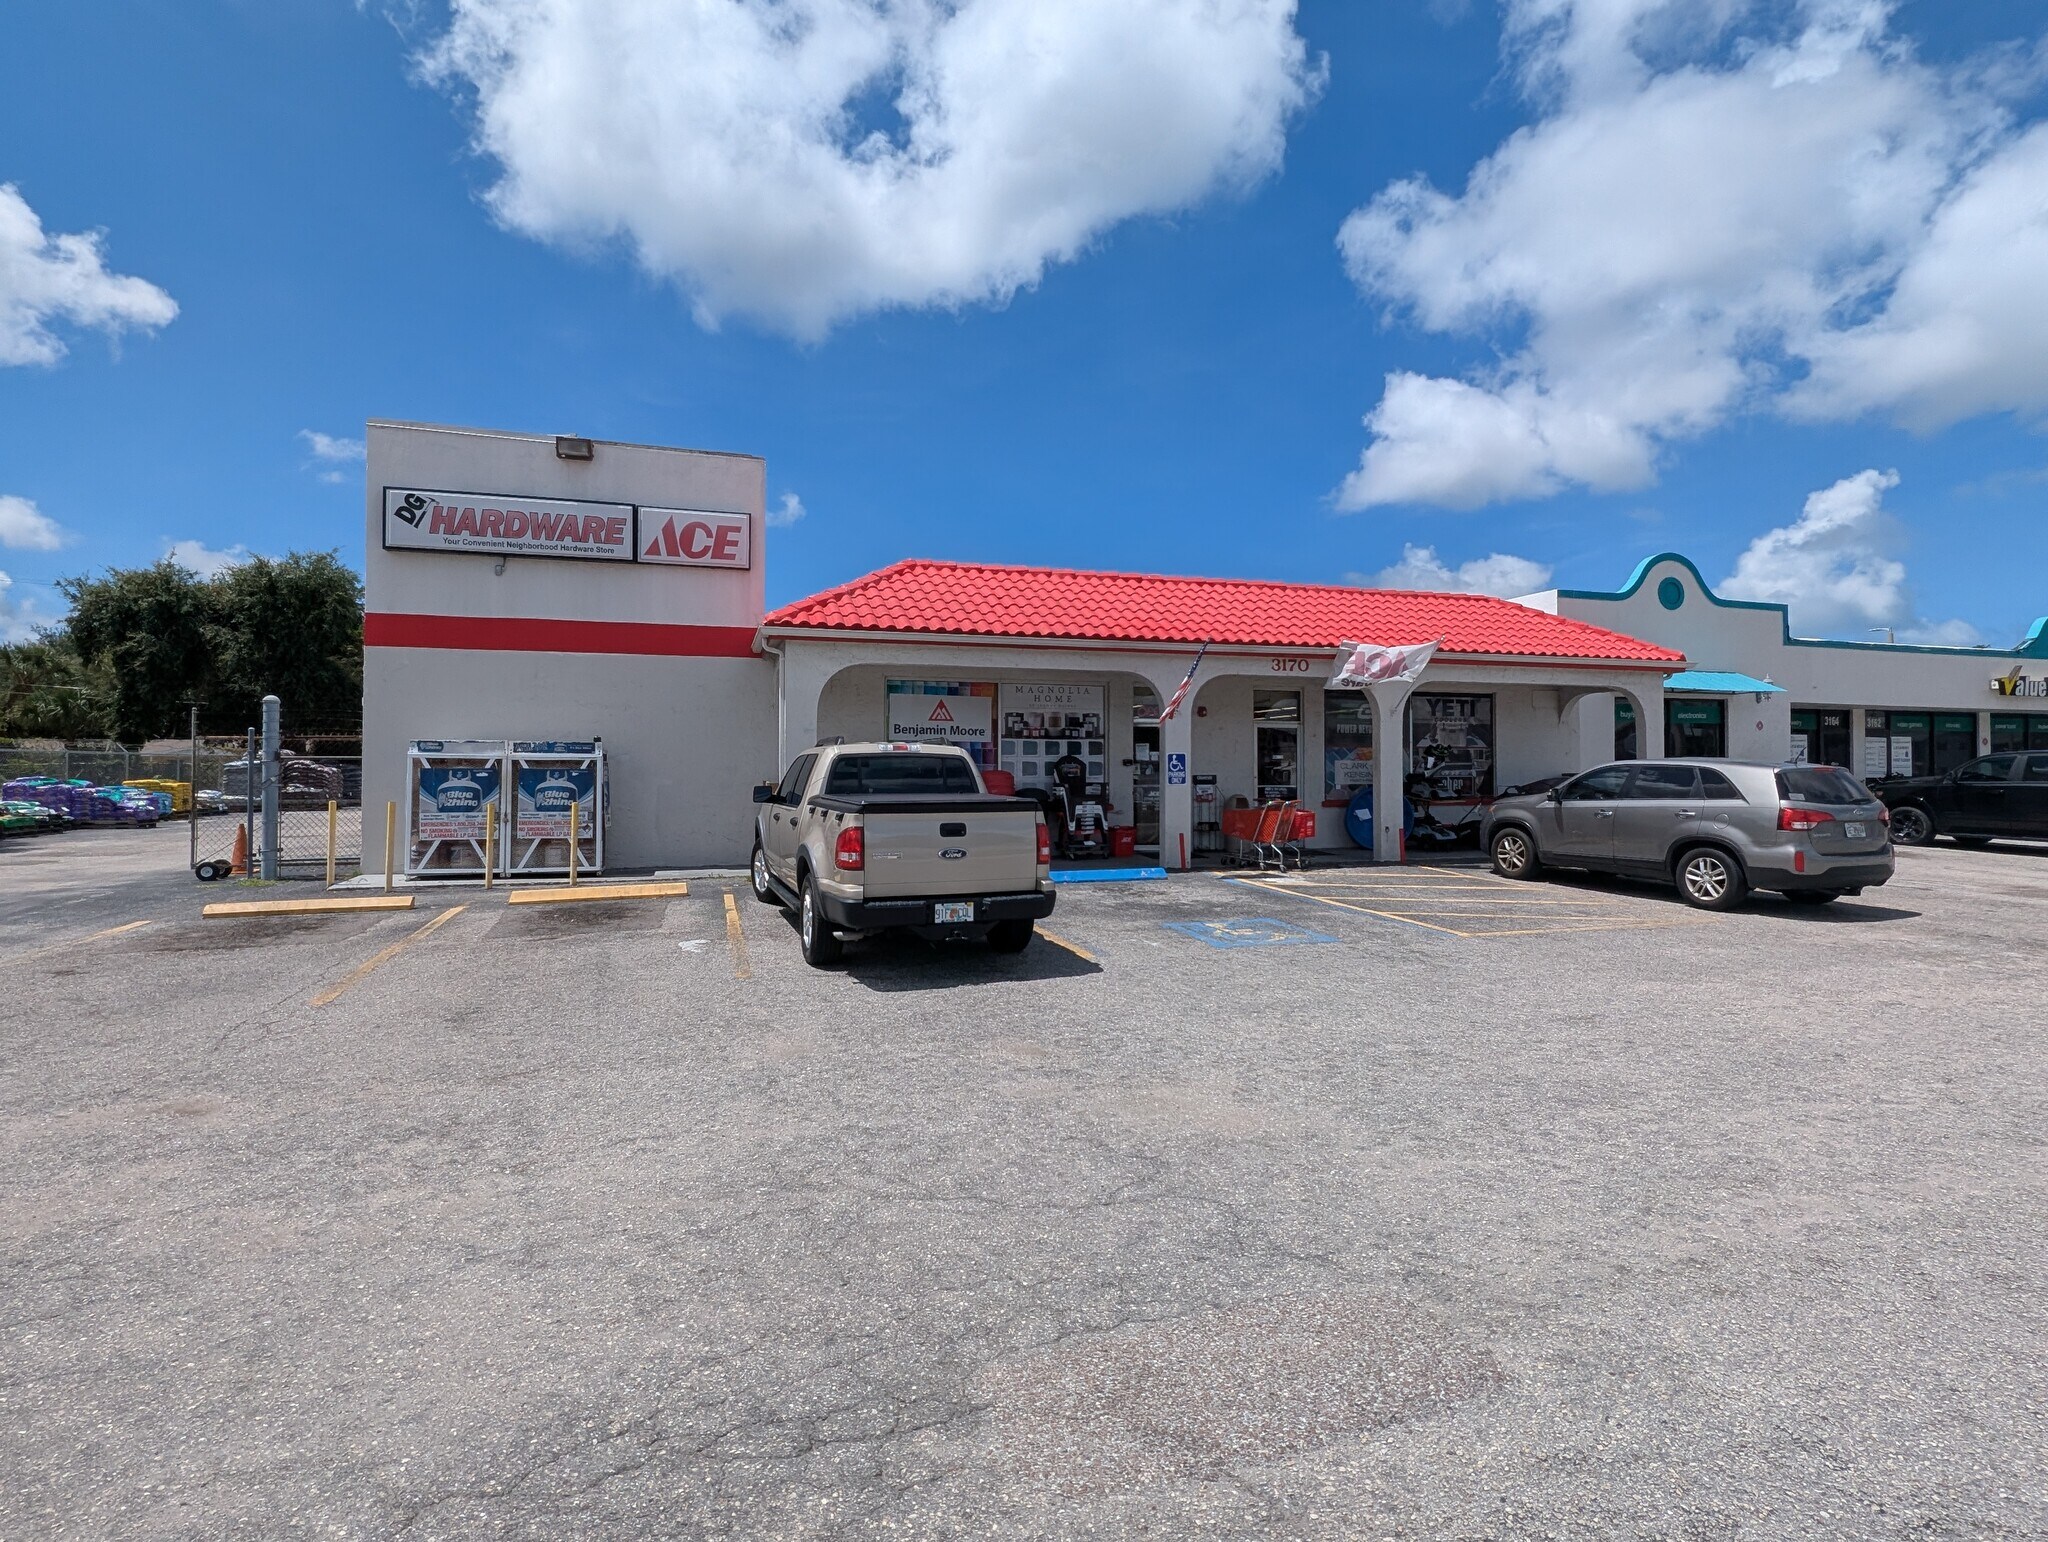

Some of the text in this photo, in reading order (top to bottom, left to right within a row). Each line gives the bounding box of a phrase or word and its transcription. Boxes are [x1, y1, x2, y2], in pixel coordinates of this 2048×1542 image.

[394, 492, 427, 525] DG
[429, 505, 627, 545] HARDWARE
[644, 515, 743, 561] ACE
[443, 537, 615, 554] Your Convenient Neighborhood Hardware Store
[1271, 658, 1310, 672] 3170
[2001, 665, 2047, 697] Value
[1015, 685, 1091, 695] MAGNOLIA
[1033, 694, 1073, 703] HOME
[1426, 698, 1475, 717] YETI
[1824, 716, 1839, 726] 3164
[893, 724, 986, 737] Benjamin Moore
[1337, 724, 1357, 733] POWER
[1340, 762, 1369, 770] CLARK
[447, 790, 474, 799] Blue
[544, 790, 570, 799] Blue
[945, 849, 962, 858] Ford
[935, 908, 950, 920] 91F
